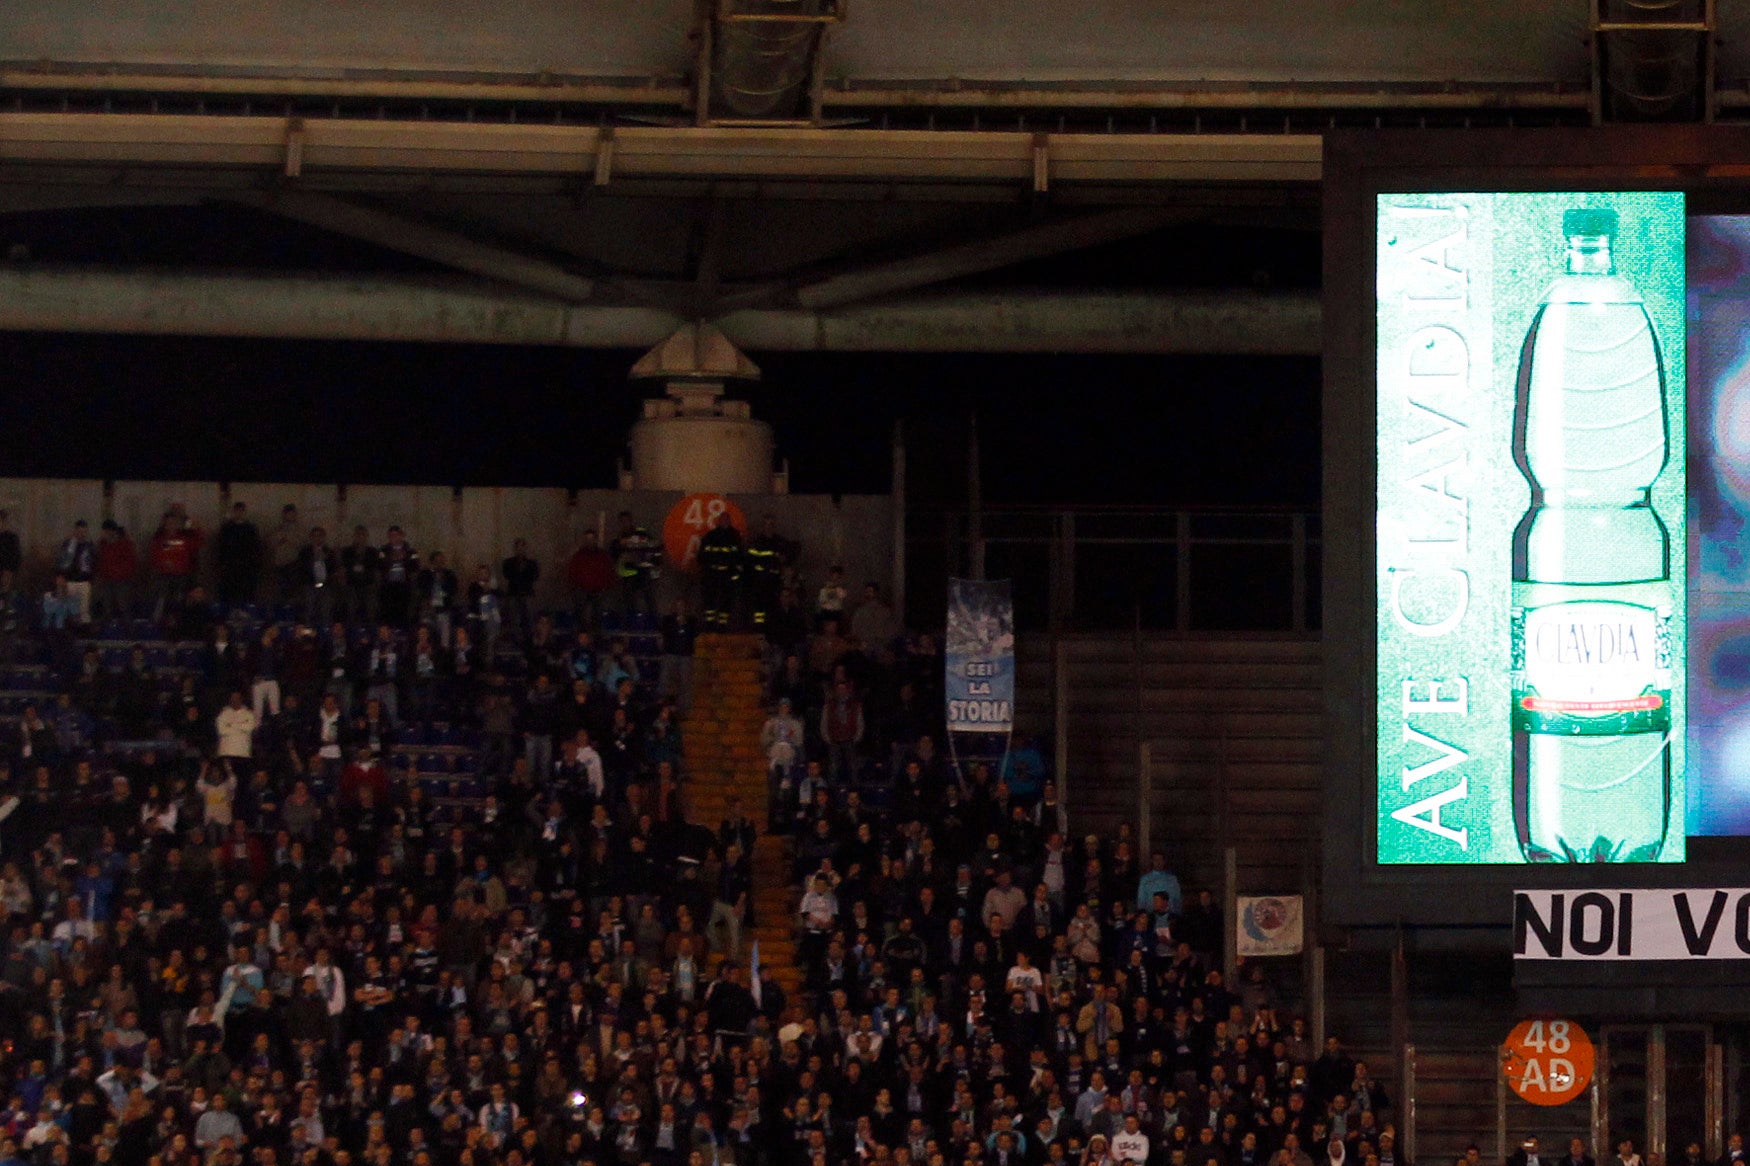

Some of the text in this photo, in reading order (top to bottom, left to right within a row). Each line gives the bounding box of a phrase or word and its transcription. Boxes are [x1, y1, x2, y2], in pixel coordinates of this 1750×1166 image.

[950, 700, 1010, 722] STORIA
[1391, 677, 1468, 850] AVE
[1515, 892, 1633, 957] NOI
[1523, 1020, 1571, 1054] 48
[1520, 1058, 1575, 1092] AD
